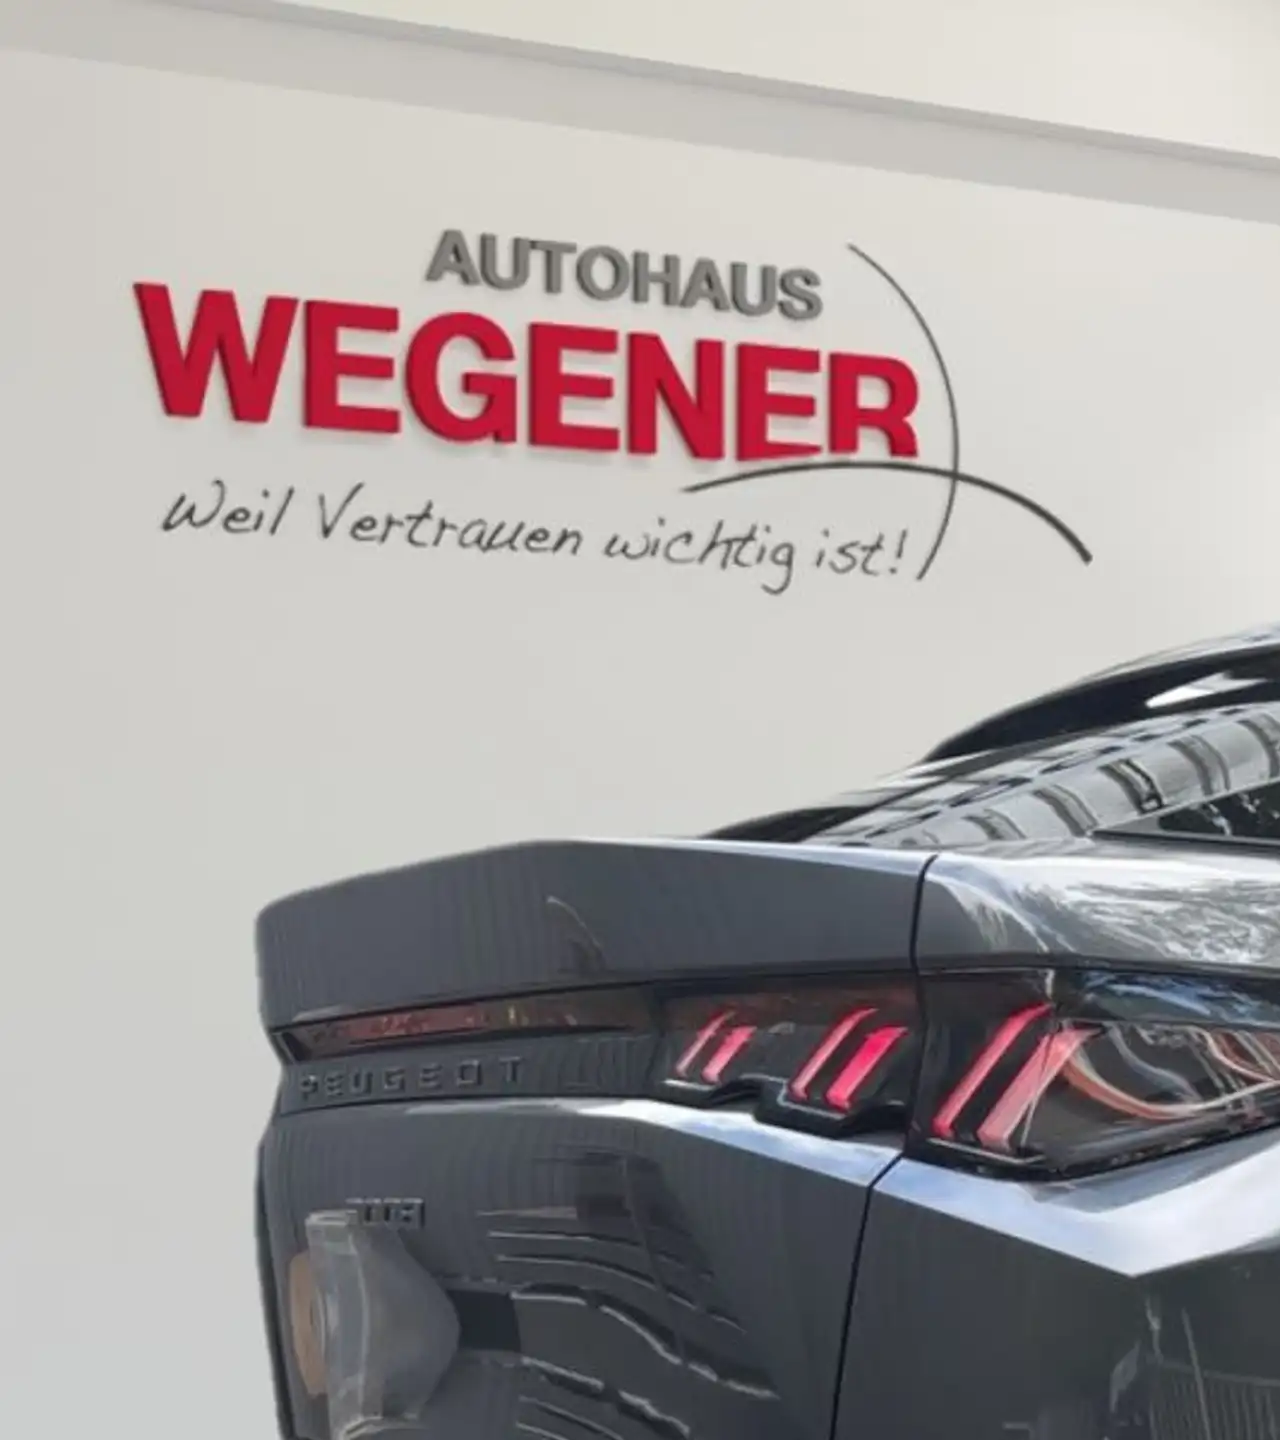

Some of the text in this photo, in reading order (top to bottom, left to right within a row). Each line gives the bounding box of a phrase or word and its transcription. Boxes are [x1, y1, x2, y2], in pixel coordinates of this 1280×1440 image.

[425, 229, 823, 321] AUTOHAUS
[132, 282, 920, 463] WEGENER
[161, 479, 908, 596] Weil Vertrauen wichtig ist!
[301, 1056, 524, 1099] PEUGEOT
